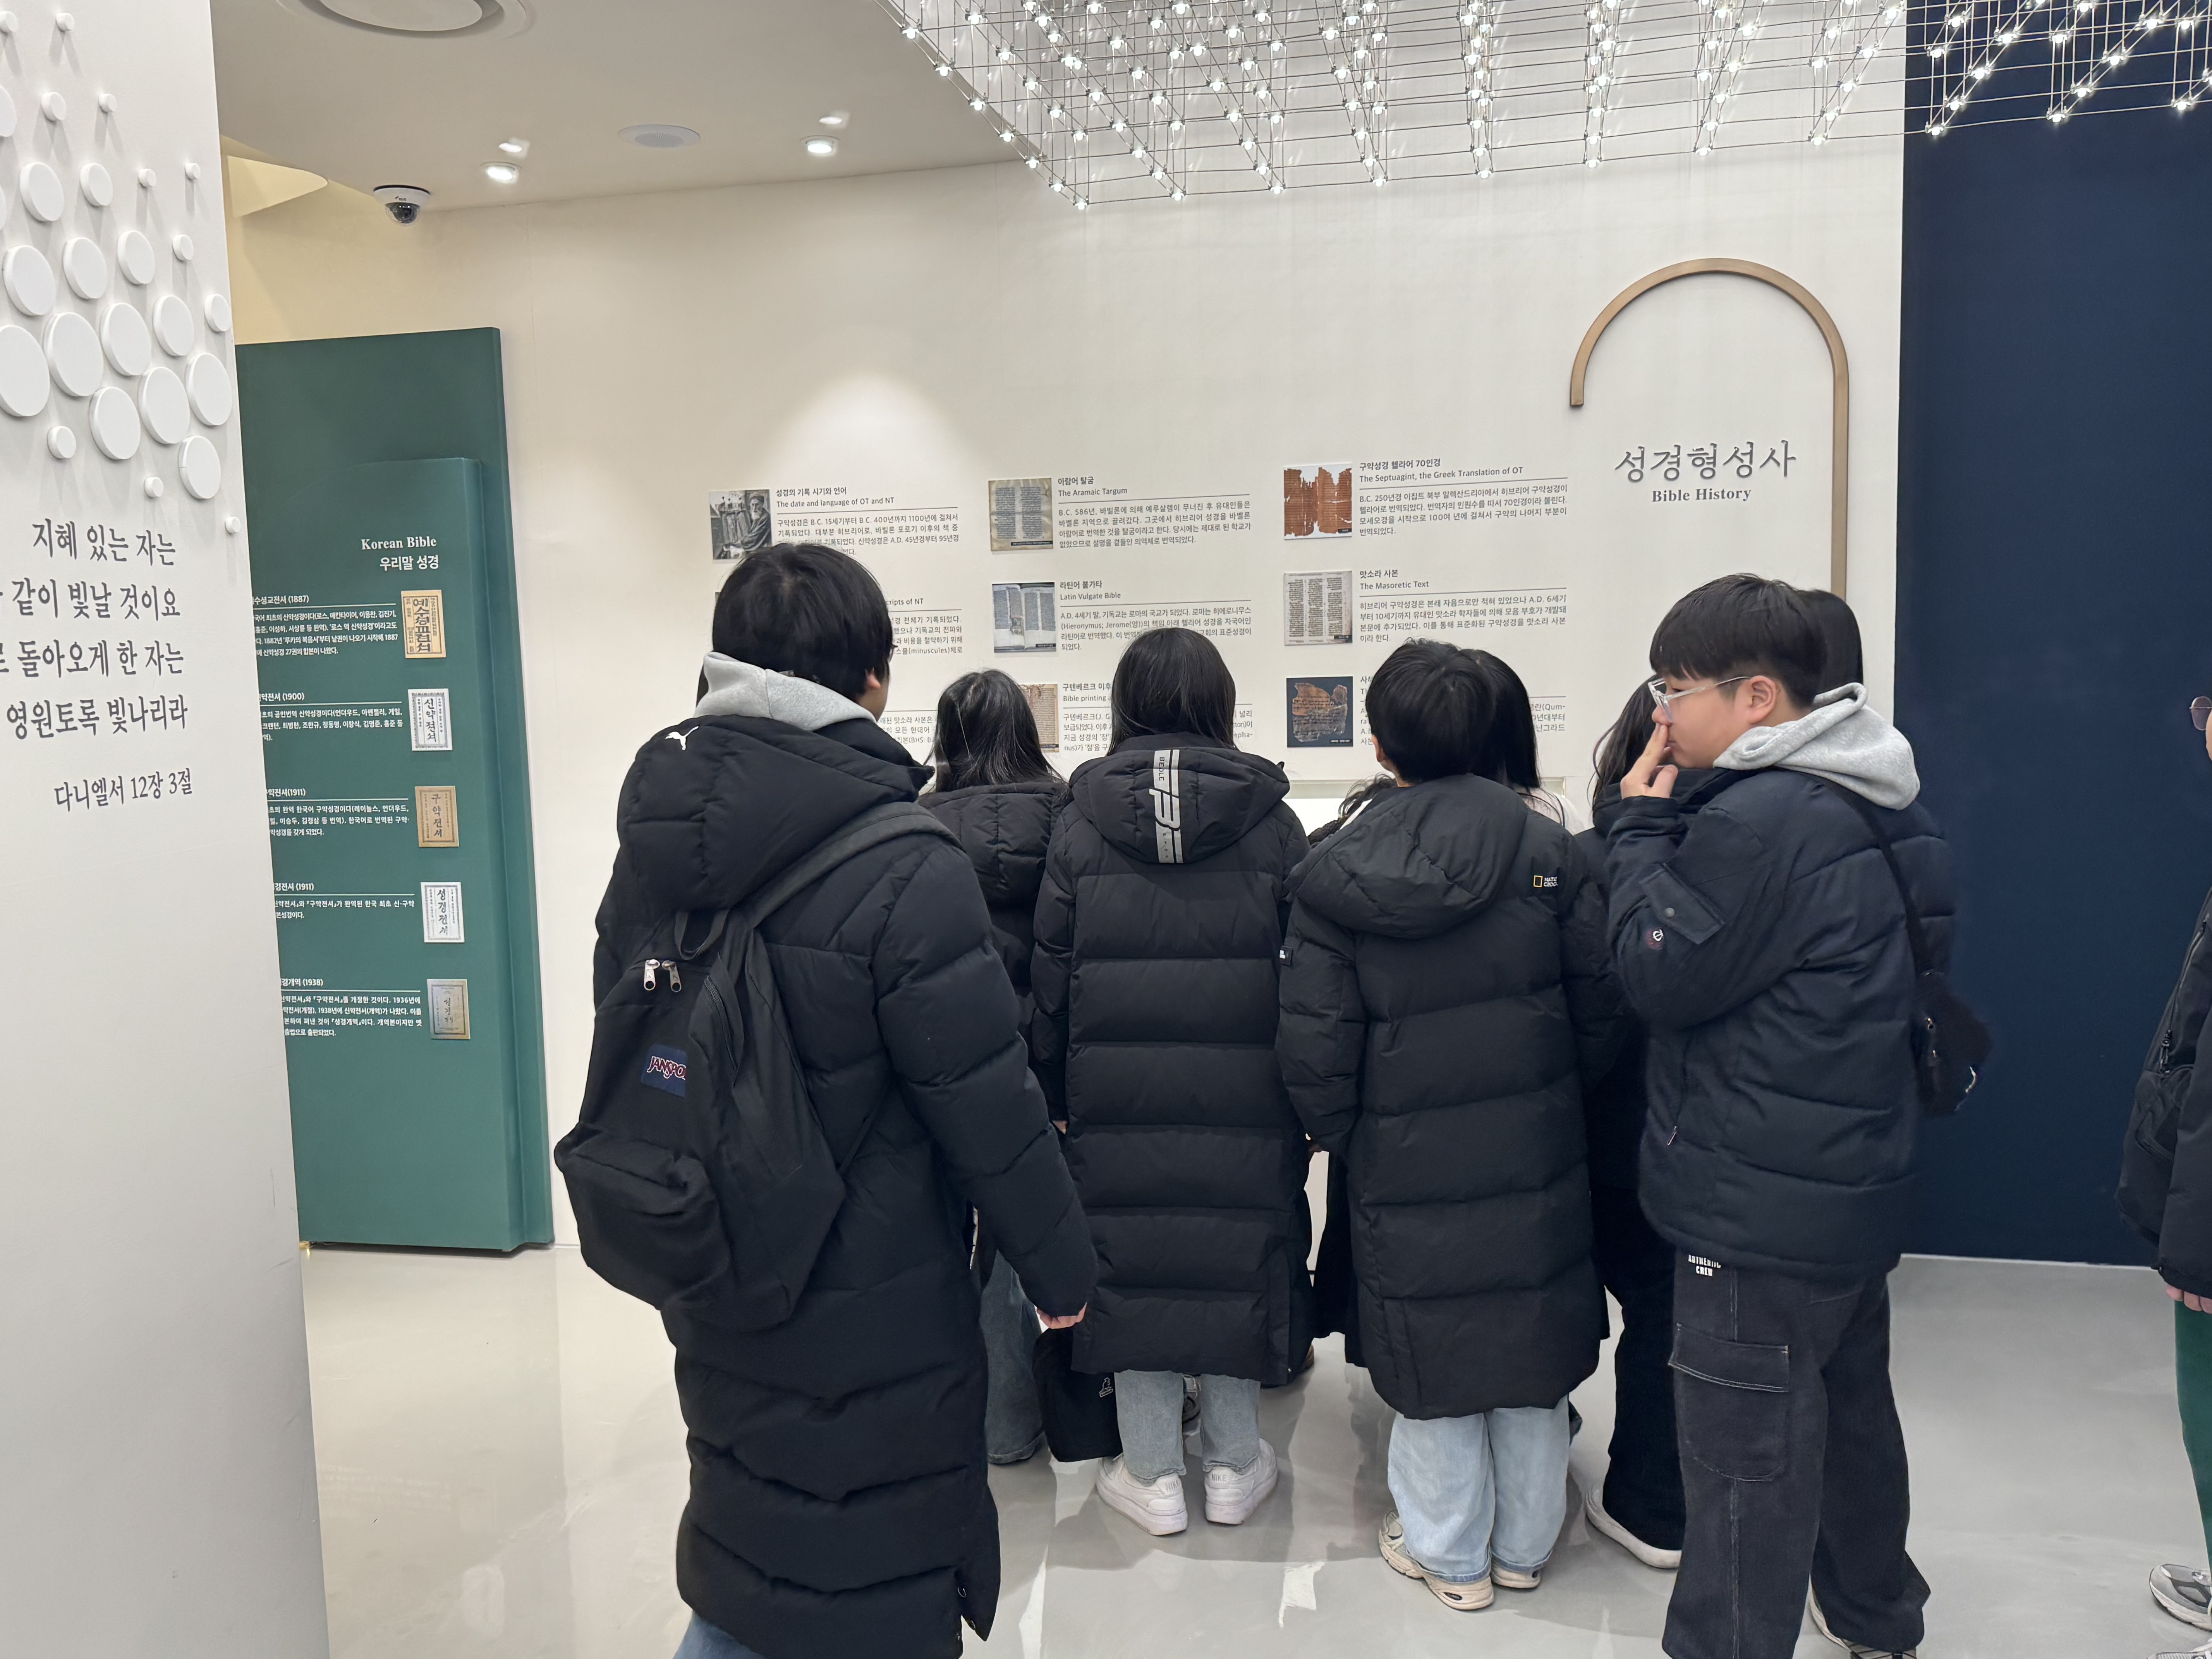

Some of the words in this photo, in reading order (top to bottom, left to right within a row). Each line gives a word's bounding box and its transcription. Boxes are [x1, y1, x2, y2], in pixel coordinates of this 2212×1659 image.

[1359, 461, 1388, 471] 구약성경
[1391, 460, 1413, 469] 헬라어
[1416, 458, 1440, 467] 70인경
[1614, 440, 1796, 483] 성경형성사
[1375, 473, 1417, 482] Septuagint,
[1434, 470, 1455, 478] Greek
[1458, 468, 1500, 476] Translation
[1058, 477, 1078, 486] 아람어
[776, 488, 795, 497] 성경의
[812, 487, 831, 495] 시기와
[833, 486, 847, 495] 언어
[1501, 486, 1529, 495] 히브리어
[1652, 489, 1689, 502] Bible
[1696, 488, 1750, 501] History
[1183, 503, 1203, 511] 무너진
[1082, 518, 1109, 526] 지역으로
[1144, 515, 1171, 523] 그곳에서
[1175, 514, 1202, 522] 히브리어
[1206, 512, 1226, 521] 성경을
[1398, 514, 1426, 523] 시작으로
[1429, 513, 1450, 521] 100여
[1495, 509, 1516, 518] 구약의
[1519, 508, 1541, 517] 나머지
[1086, 529, 1105, 537] 번역한
[1156, 526, 1171, 534] 한다.
[1173, 525, 1199, 533] 당시에는
[1231, 522, 1251, 531] 학교가
[32, 518, 77, 560] 지혜
[87, 524, 129, 562] 있는
[136, 529, 176, 566] 자는
[361, 539, 404, 550] Korean
[406, 536, 437, 548] Bible
[380, 555, 414, 571] 우리말
[416, 554, 439, 570] 성경
[1360, 569, 1381, 579] 맛소라
[1384, 569, 1398, 577] 사본
[1060, 581, 1080, 589] 라틴어
[11, 577, 58, 618] 같이
[67, 581, 112, 619] 빛날
[120, 584, 180, 622] 것이요
[252, 595, 286, 605] 수성교전서
[288, 594, 309, 603] (1887)
[1360, 601, 1387, 610] 히브리어
[1102, 610, 1127, 618] 기독교는
[1360, 613, 1373, 621] 부터
[1436, 610, 1456, 618] 맛소라
[1225, 617, 1251, 625] 자국어인
[17, 639, 109, 678] 돌아오게
[116, 640, 137, 675] 한
[144, 640, 184, 676] 자는
[1063, 683, 1096, 691] 구텐베르크
[282, 692, 304, 701] (1900)
[7, 699, 100, 740] 영원토록
[106, 694, 188, 734] 빛나리라
[1096, 723, 1108, 731] 이후
[54, 775, 124, 812] 다니엘서
[130, 771, 163, 799] 12장
[168, 768, 192, 795] 3절
[268, 788, 306, 797] 약전서(1911)
[275, 883, 294, 891] 경전서
[295, 883, 314, 891] (1911)
[281, 978, 301, 986] 경개역
[302, 978, 323, 986] (1938)
[647, 1056, 686, 1080] JANSPO
[1696, 1266, 1712, 1276] CREW
[1211, 1473, 1227, 1482] NIKE
